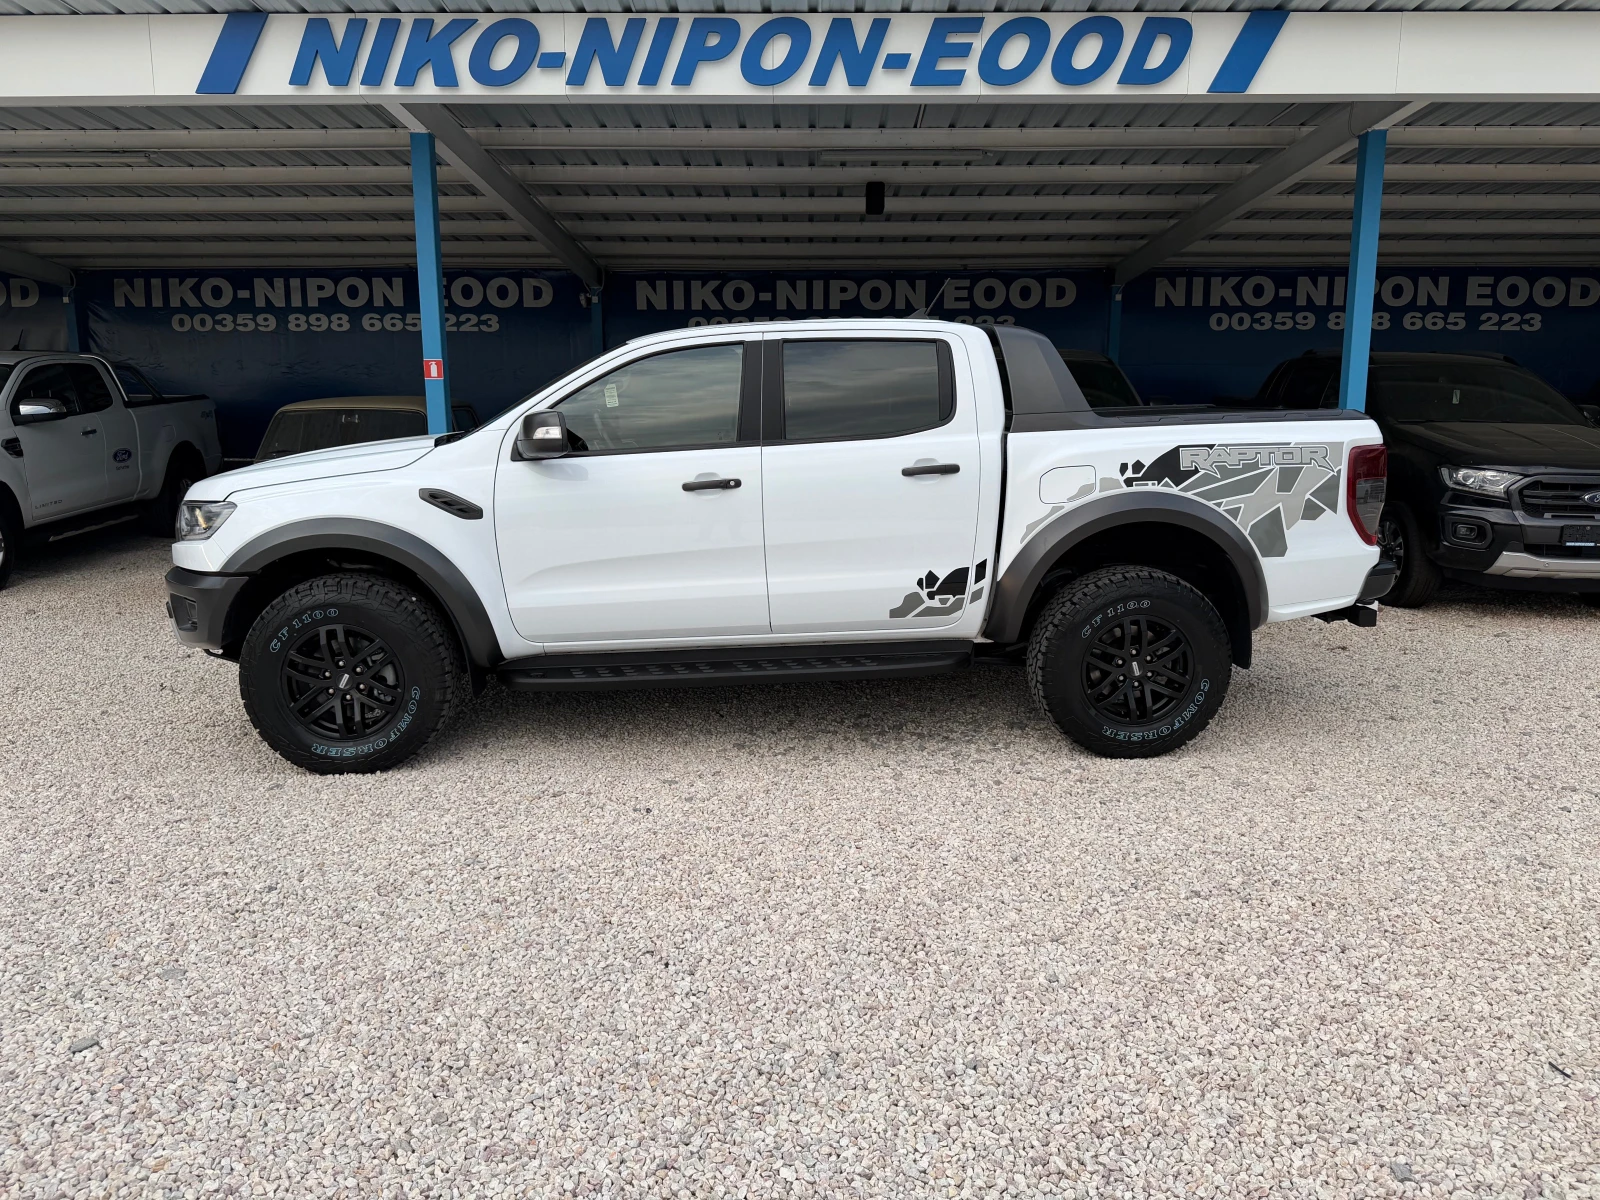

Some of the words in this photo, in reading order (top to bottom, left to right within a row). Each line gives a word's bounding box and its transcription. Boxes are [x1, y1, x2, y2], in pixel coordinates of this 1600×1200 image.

[289, 16, 1193, 87] NIKO-NIPON-EOOD
[114, 277, 404, 307] NIKO-NIPON
[636, 279, 926, 311] NIKO-NIPON
[943, 278, 1077, 310] EOOD
[1155, 276, 1451, 307] NIKO-NION
[1466, 276, 1600, 307] EOOD
[171, 313, 277, 332] 00359
[288, 313, 351, 332] 898
[361, 313, 421, 332] 665
[1209, 312, 1316, 331] 00359
[1327, 312, 1391, 331] 88
[1402, 312, 1466, 331] 665
[1478, 312, 1542, 331] 223
[1180, 446, 1337, 477] RAPTOR
[35, 500, 63, 509] LIMITED
[311, 685, 421, 757] COMFORSER
[1102, 678, 1210, 741] COMFORSER
